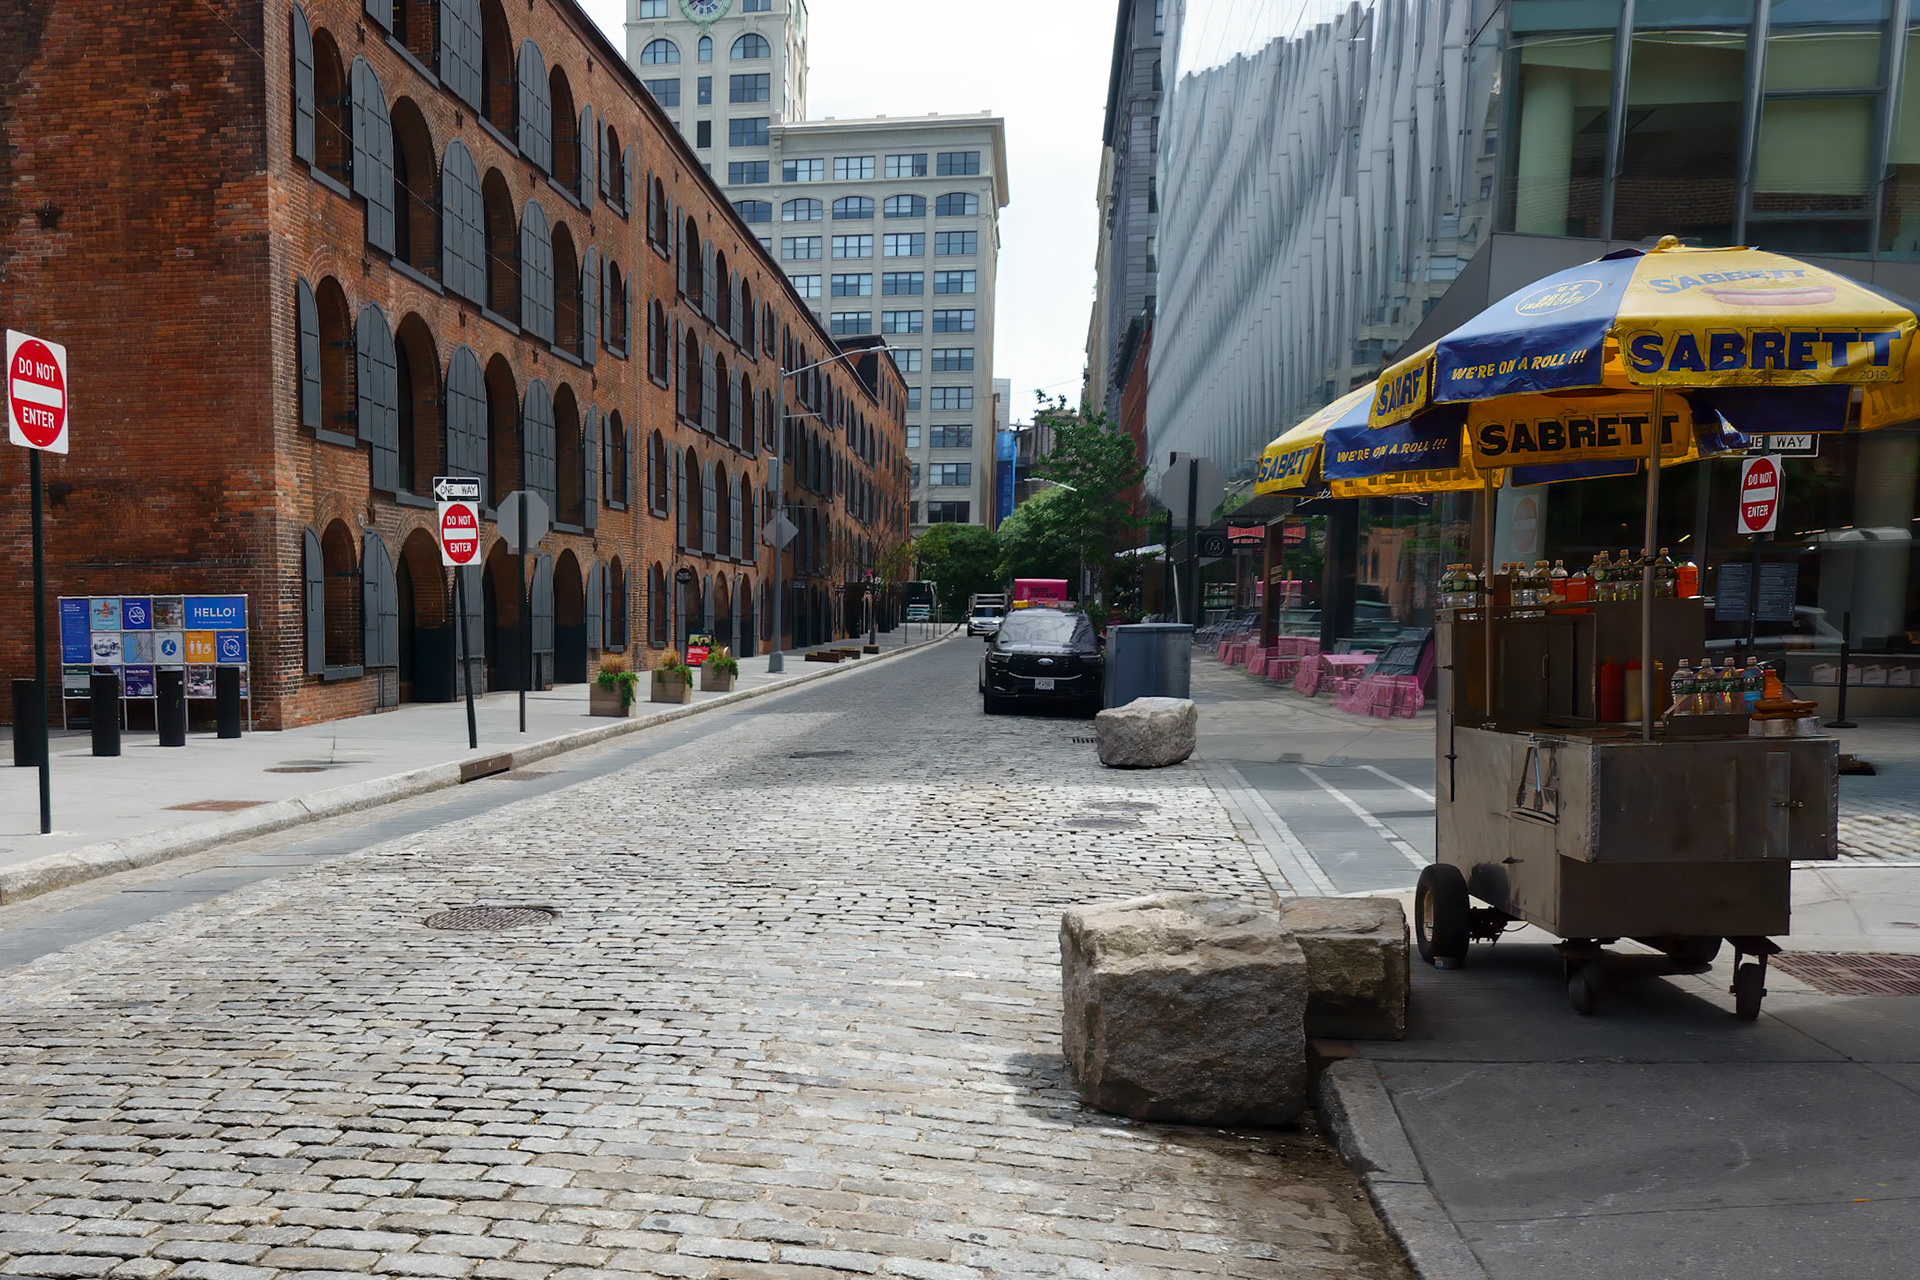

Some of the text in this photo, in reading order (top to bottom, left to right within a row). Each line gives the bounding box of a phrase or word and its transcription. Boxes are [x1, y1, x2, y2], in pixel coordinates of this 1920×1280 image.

[1646, 268, 1806, 295] SABRETT
[1626, 327, 1902, 374] SABRETT
[18, 357, 56, 382] DO NOT
[1451, 363, 1497, 381] WE'RE
[1499, 358, 1517, 375] ON
[1517, 356, 1529, 371] A
[1531, 352, 1565, 371] ROLL
[1859, 369, 1888, 381] 2019
[22, 406, 55, 429] ENTER
[1477, 412, 1679, 456] SABRETT
[1776, 436, 1806, 448] WAY
[1336, 448, 1371, 463] WE'RE
[1372, 444, 1389, 458] ON
[1389, 443, 1398, 455] A
[1400, 440, 1429, 454] ROLL
[1747, 471, 1773, 486] DO NOT
[440, 485, 476, 495] ONE WAY
[1747, 504, 1769, 518] ENTER
[446, 515, 471, 526] DO NOT
[450, 542, 472, 553] ENTER
[194, 607, 236, 618] HELLO!
